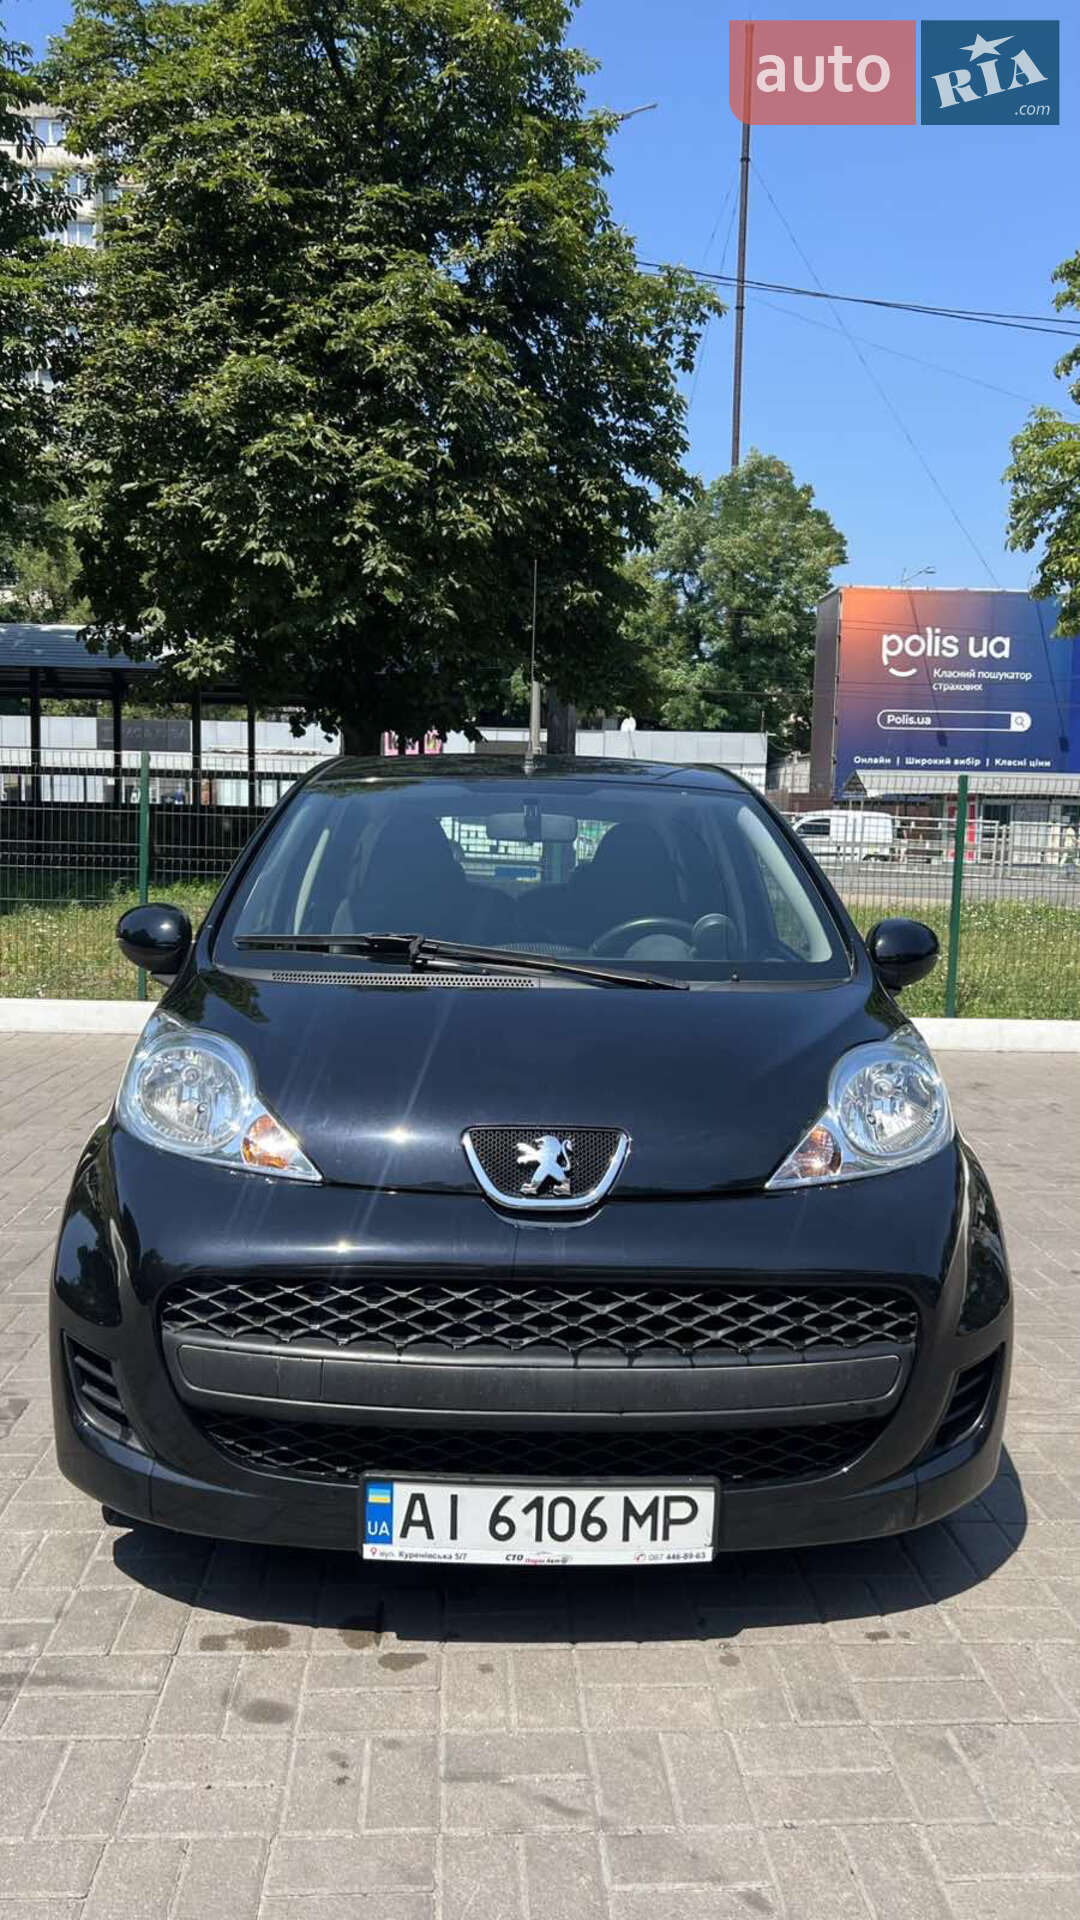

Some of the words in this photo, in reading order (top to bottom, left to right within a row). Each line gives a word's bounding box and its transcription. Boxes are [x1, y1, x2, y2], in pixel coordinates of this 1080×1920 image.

[882, 627, 959, 666] polis
[968, 635, 1010, 659] ua
[933, 668, 976, 679] Класний
[977, 671, 1032, 681] пошукатор
[932, 683, 983, 692] страхових
[886, 714, 932, 726] Polis.ua
[853, 755, 892, 765] Онлайн
[905, 755, 951, 767] Широкий
[953, 757, 982, 767] вибір
[994, 757, 1027, 767] Класні
[1029, 758, 1051, 768] ціни
[400, 1493, 458, 1540] AI
[488, 1495, 608, 1542] 6106
[622, 1495, 699, 1541] MP
[367, 1521, 390, 1536] UA
[505, 1553, 524, 1561] СТО
